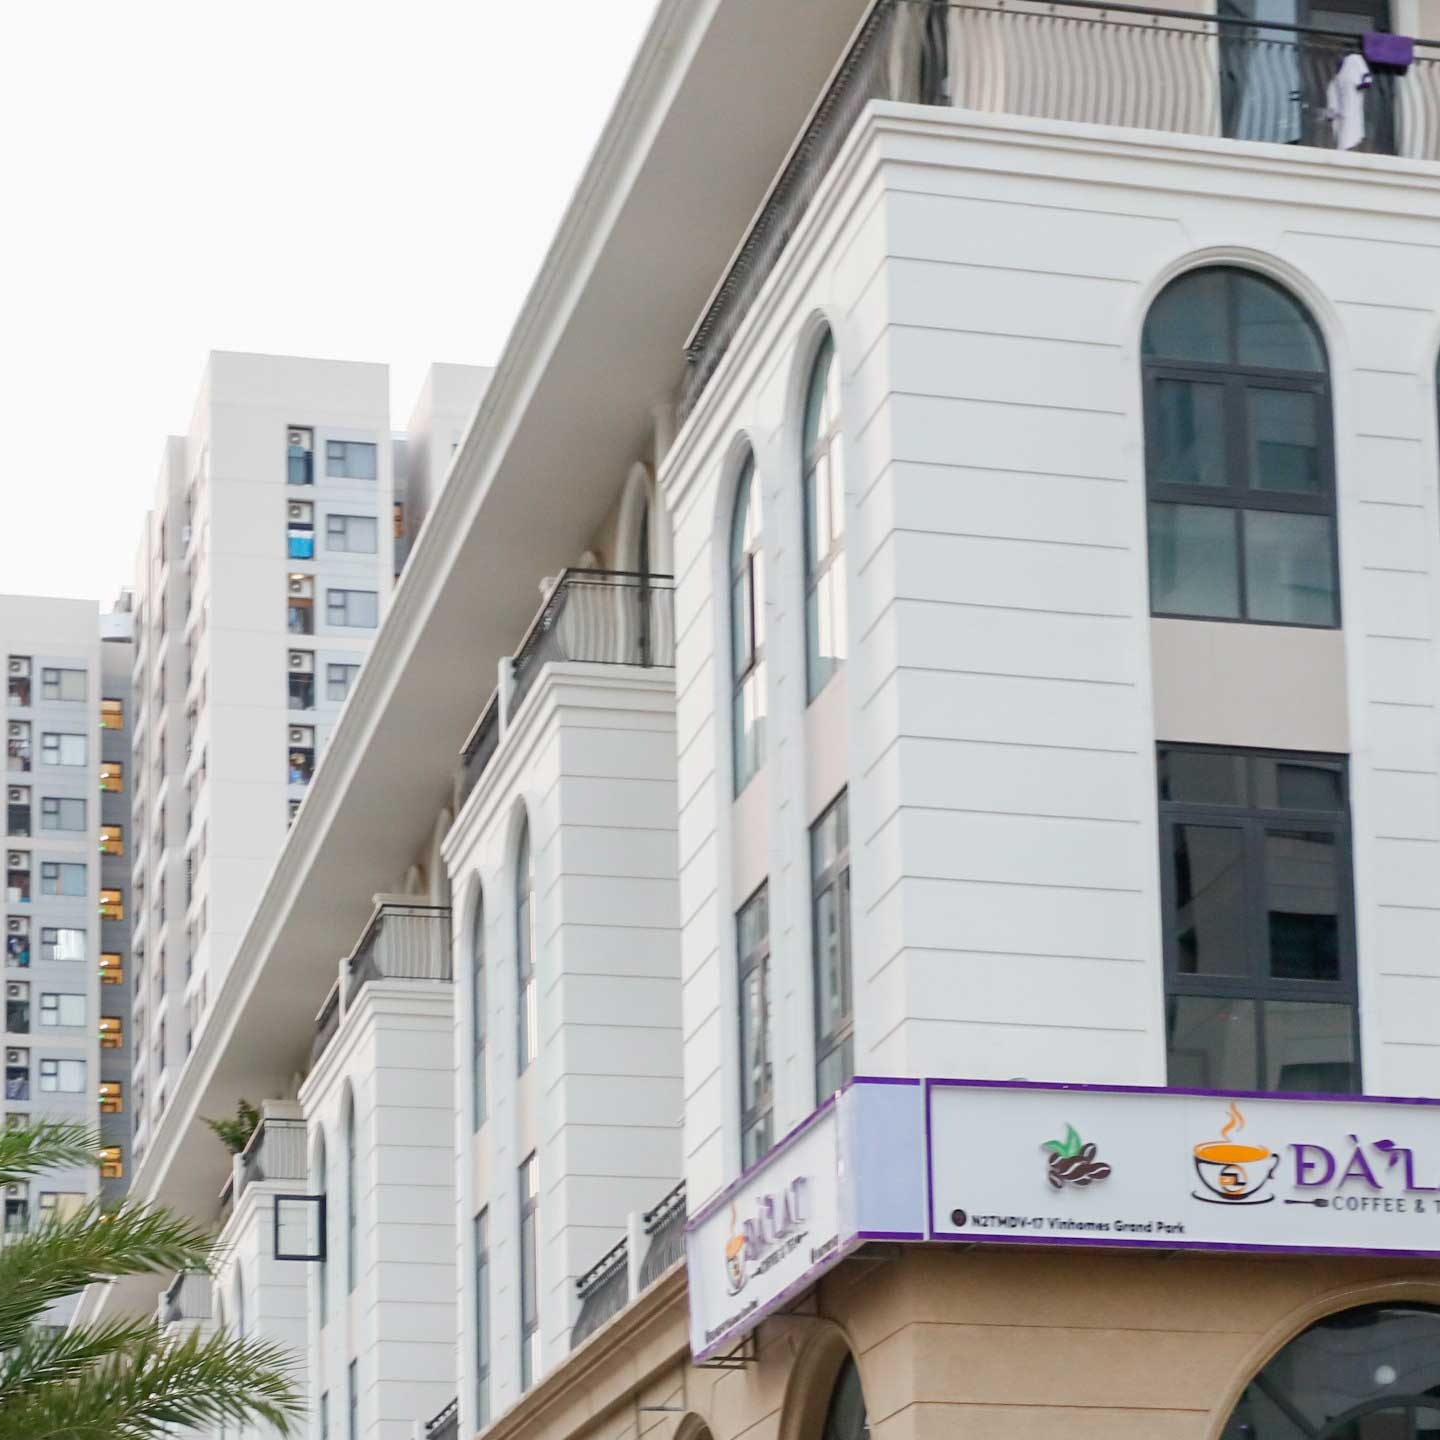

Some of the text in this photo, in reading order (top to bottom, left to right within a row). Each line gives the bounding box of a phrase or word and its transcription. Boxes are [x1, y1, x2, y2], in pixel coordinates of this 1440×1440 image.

[1332, 1195, 1407, 1213] COFFEE
[1414, 1199, 1425, 1213] &
[1048, 1217, 1110, 1232] Vinhomes
[1113, 1220, 1153, 1234] Grand
[1156, 1221, 1185, 1234] Park
